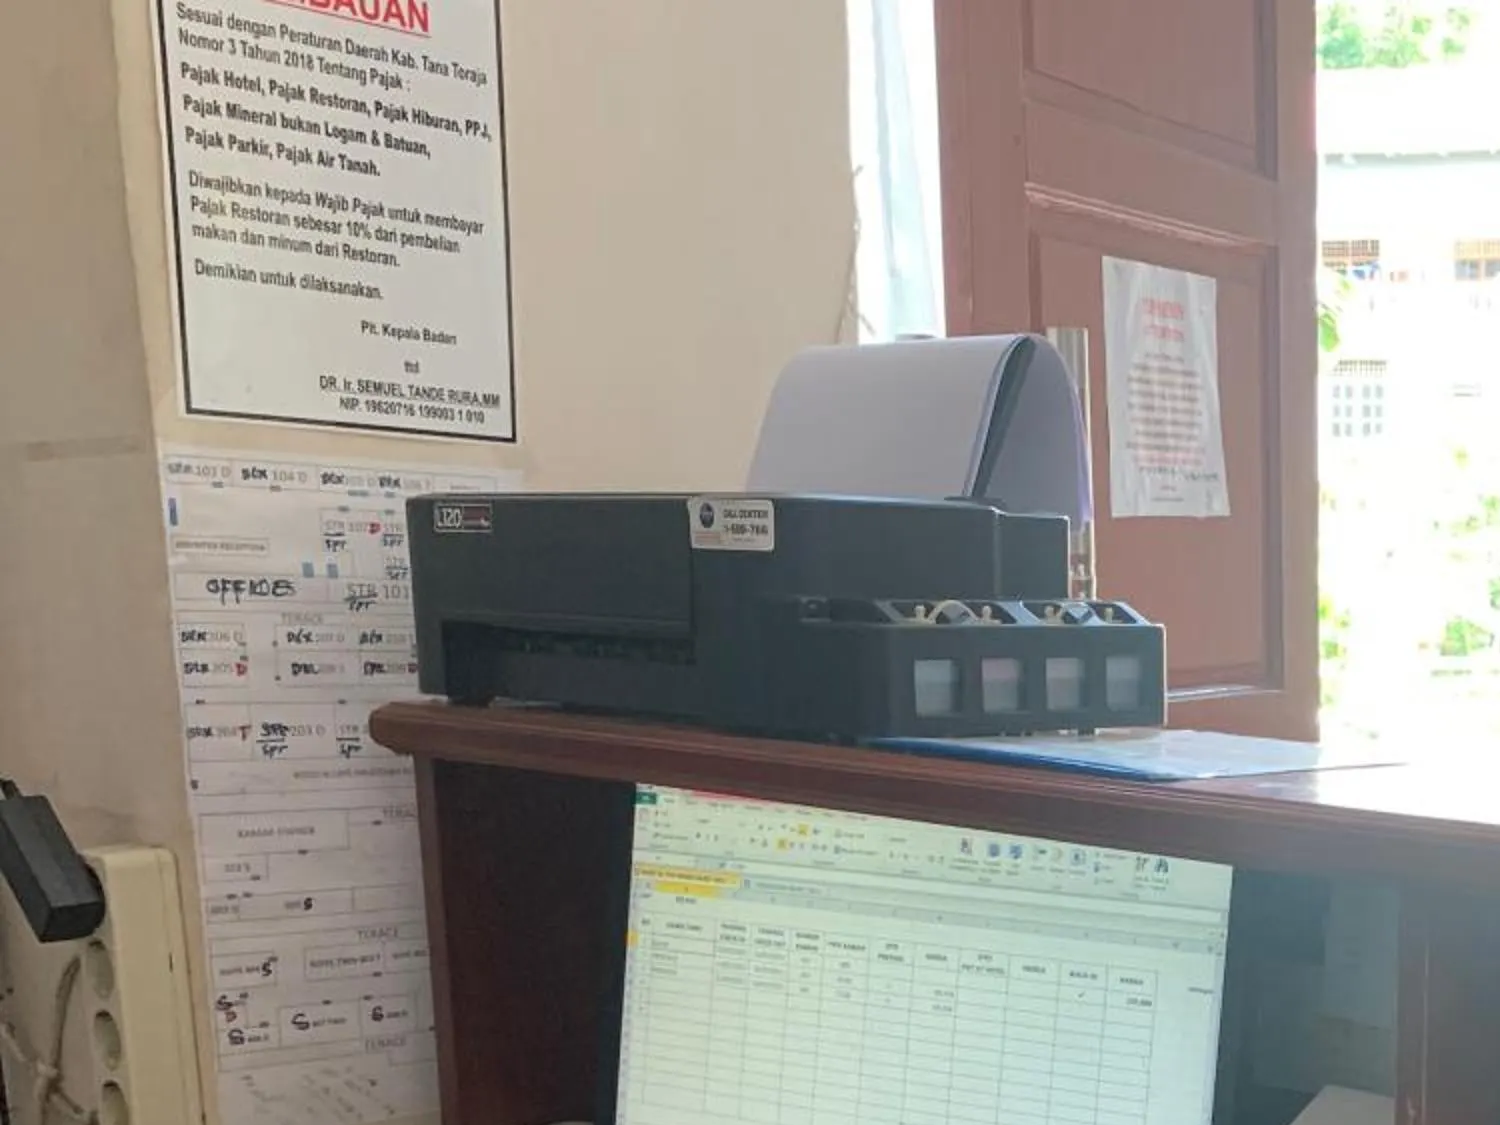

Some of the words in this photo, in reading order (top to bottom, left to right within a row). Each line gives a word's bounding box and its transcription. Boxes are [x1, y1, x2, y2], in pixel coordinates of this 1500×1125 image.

[176, 2, 223, 24] Sesuai
[227, 13, 276, 38] dengan
[280, 24, 342, 53] Peraturan
[345, 38, 389, 62] Daerah
[391, 49, 418, 70] Kab.
[422, 56, 449, 77] Tana
[451, 62, 487, 87] Toraja
[178, 27, 225, 53] Nomor
[228, 38, 236, 55] 3
[240, 40, 280, 65] Tahun
[283, 50, 314, 71] 2018
[316, 56, 367, 87] Tentang
[370, 68, 403, 91] Pajak
[181, 62, 220, 86] Pajak
[224, 71, 265, 96] Hotel,
[269, 79, 305, 103] Pajak
[309, 87, 371, 117] Restoran,
[375, 101, 409, 123] Pajak
[412, 108, 463, 136] Hiburan,
[183, 94, 222, 118] Pajak
[225, 101, 276, 127] Mineral
[280, 113, 321, 135] bukan
[324, 121, 367, 144] Logam
[371, 129, 381, 147] &
[384, 132, 431, 160] Batuan,
[185, 126, 224, 150] Pajak
[228, 134, 273, 160] Parkir,
[276, 143, 312, 166] Pajak
[317, 150, 335, 168] Air
[338, 154, 380, 176] Tanah.
[189, 170, 262, 198] Diwajibkan
[265, 183, 311, 206] kepada
[315, 192, 349, 214] Wajib
[352, 197, 385, 219] Pajak
[388, 207, 421, 224] untuk
[424, 213, 485, 236] membayar
[191, 196, 227, 218] Pajak
[231, 201, 290, 226] Restoran
[293, 214, 342, 235] sebesar
[346, 220, 372, 240] 10%
[375, 226, 398, 243] dari
[400, 232, 460, 253] pembelian
[192, 223, 237, 243] makan
[240, 230, 265, 248] dan
[269, 234, 312, 254] minum
[315, 241, 339, 258] dari
[342, 243, 400, 267] Restoran.
[195, 258, 256, 283] Demikian
[260, 271, 296, 288] untuk
[300, 273, 384, 300] dilaksanakan.
